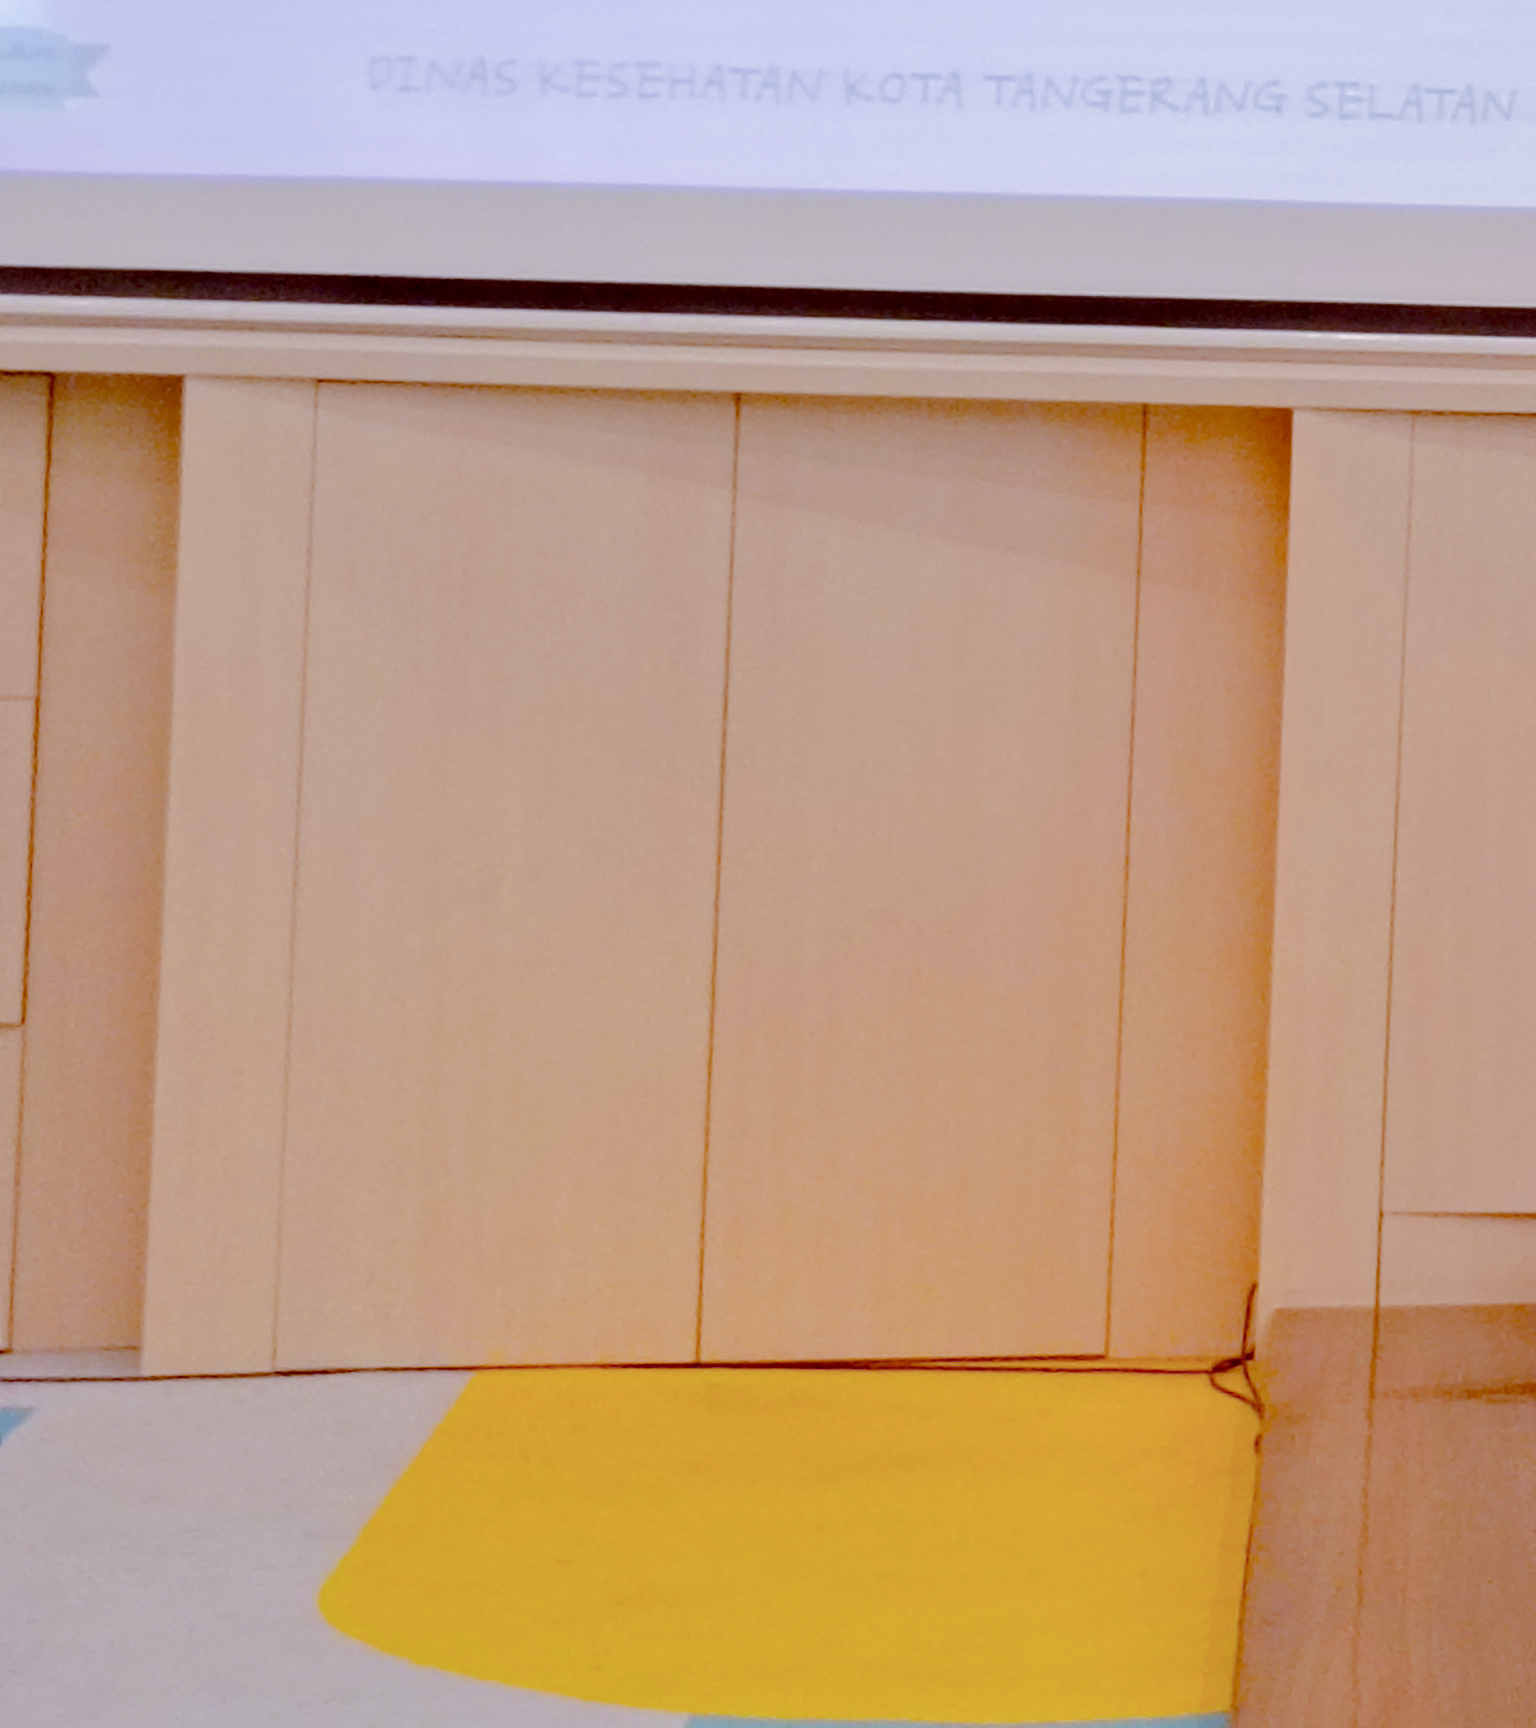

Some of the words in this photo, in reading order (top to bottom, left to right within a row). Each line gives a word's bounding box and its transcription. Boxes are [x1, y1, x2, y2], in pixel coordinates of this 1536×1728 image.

[368, 54, 519, 98] DINAS
[534, 57, 827, 106] KESEHATAN
[843, 67, 964, 110] KOTA
[981, 73, 1288, 116] TANGERANG
[1305, 79, 1519, 124] SELATAN
